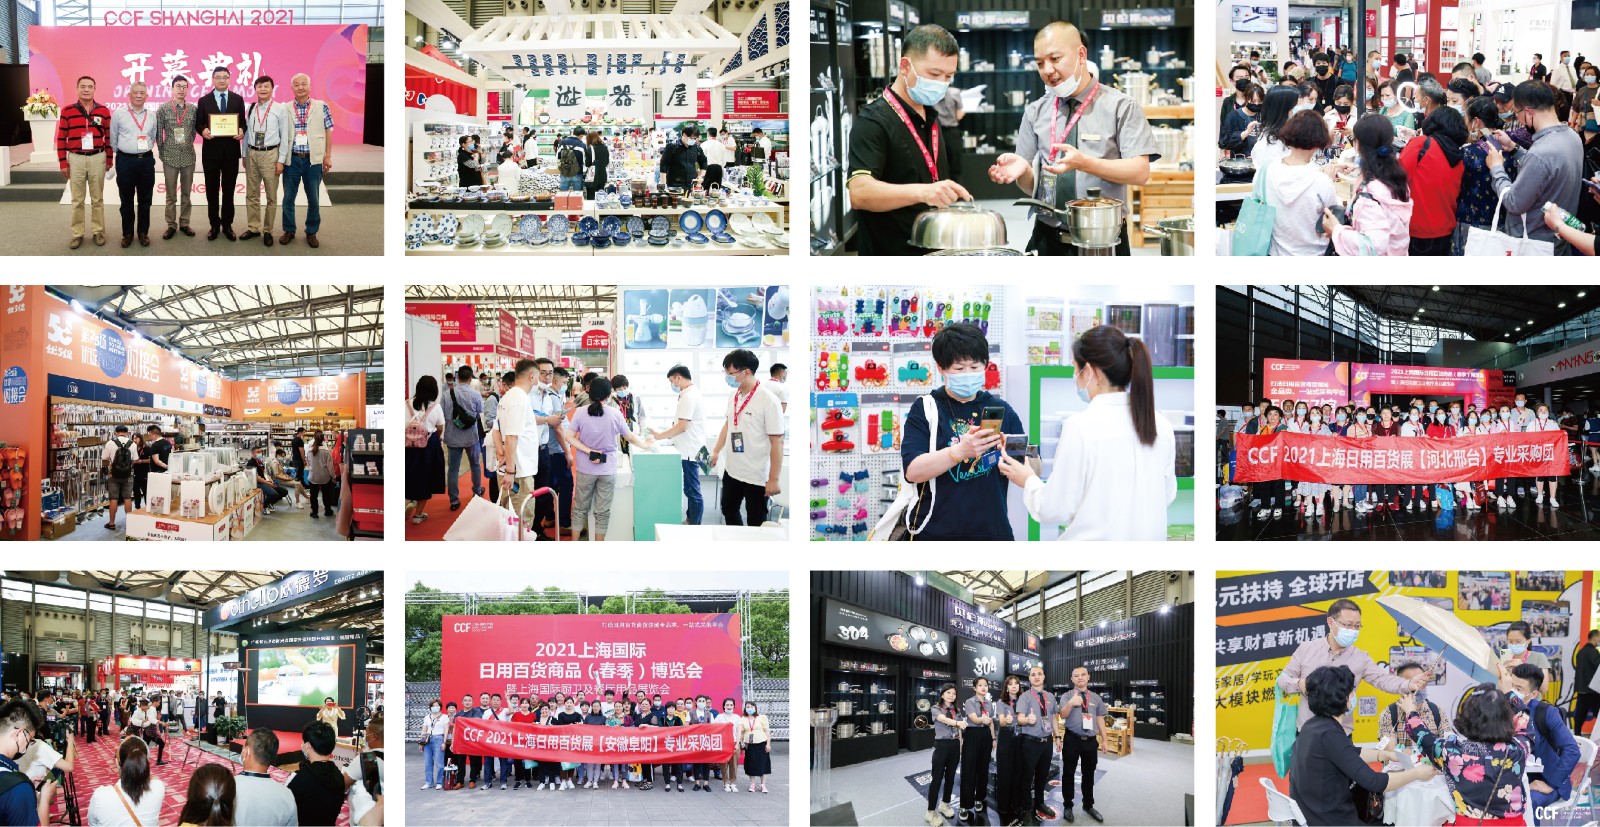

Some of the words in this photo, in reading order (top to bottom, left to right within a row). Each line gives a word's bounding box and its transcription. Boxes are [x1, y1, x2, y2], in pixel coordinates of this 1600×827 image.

[103, 11, 144, 26] CCF
[150, 10, 244, 26] SHANGHAI
[250, 9, 294, 25] 2021
[1270, 363, 1284, 371] CCF
[301, 382, 339, 402] 对接会
[1248, 445, 1278, 465] CCF
[1216, 579, 1283, 607] 元扶持
[1288, 571, 1365, 598] 全球开店
[453, 622, 472, 633] CCF
[837, 625, 869, 641] 304
[535, 641, 647, 659] 2021上海国际
[973, 655, 998, 676] 304
[463, 727, 484, 742] CCF
